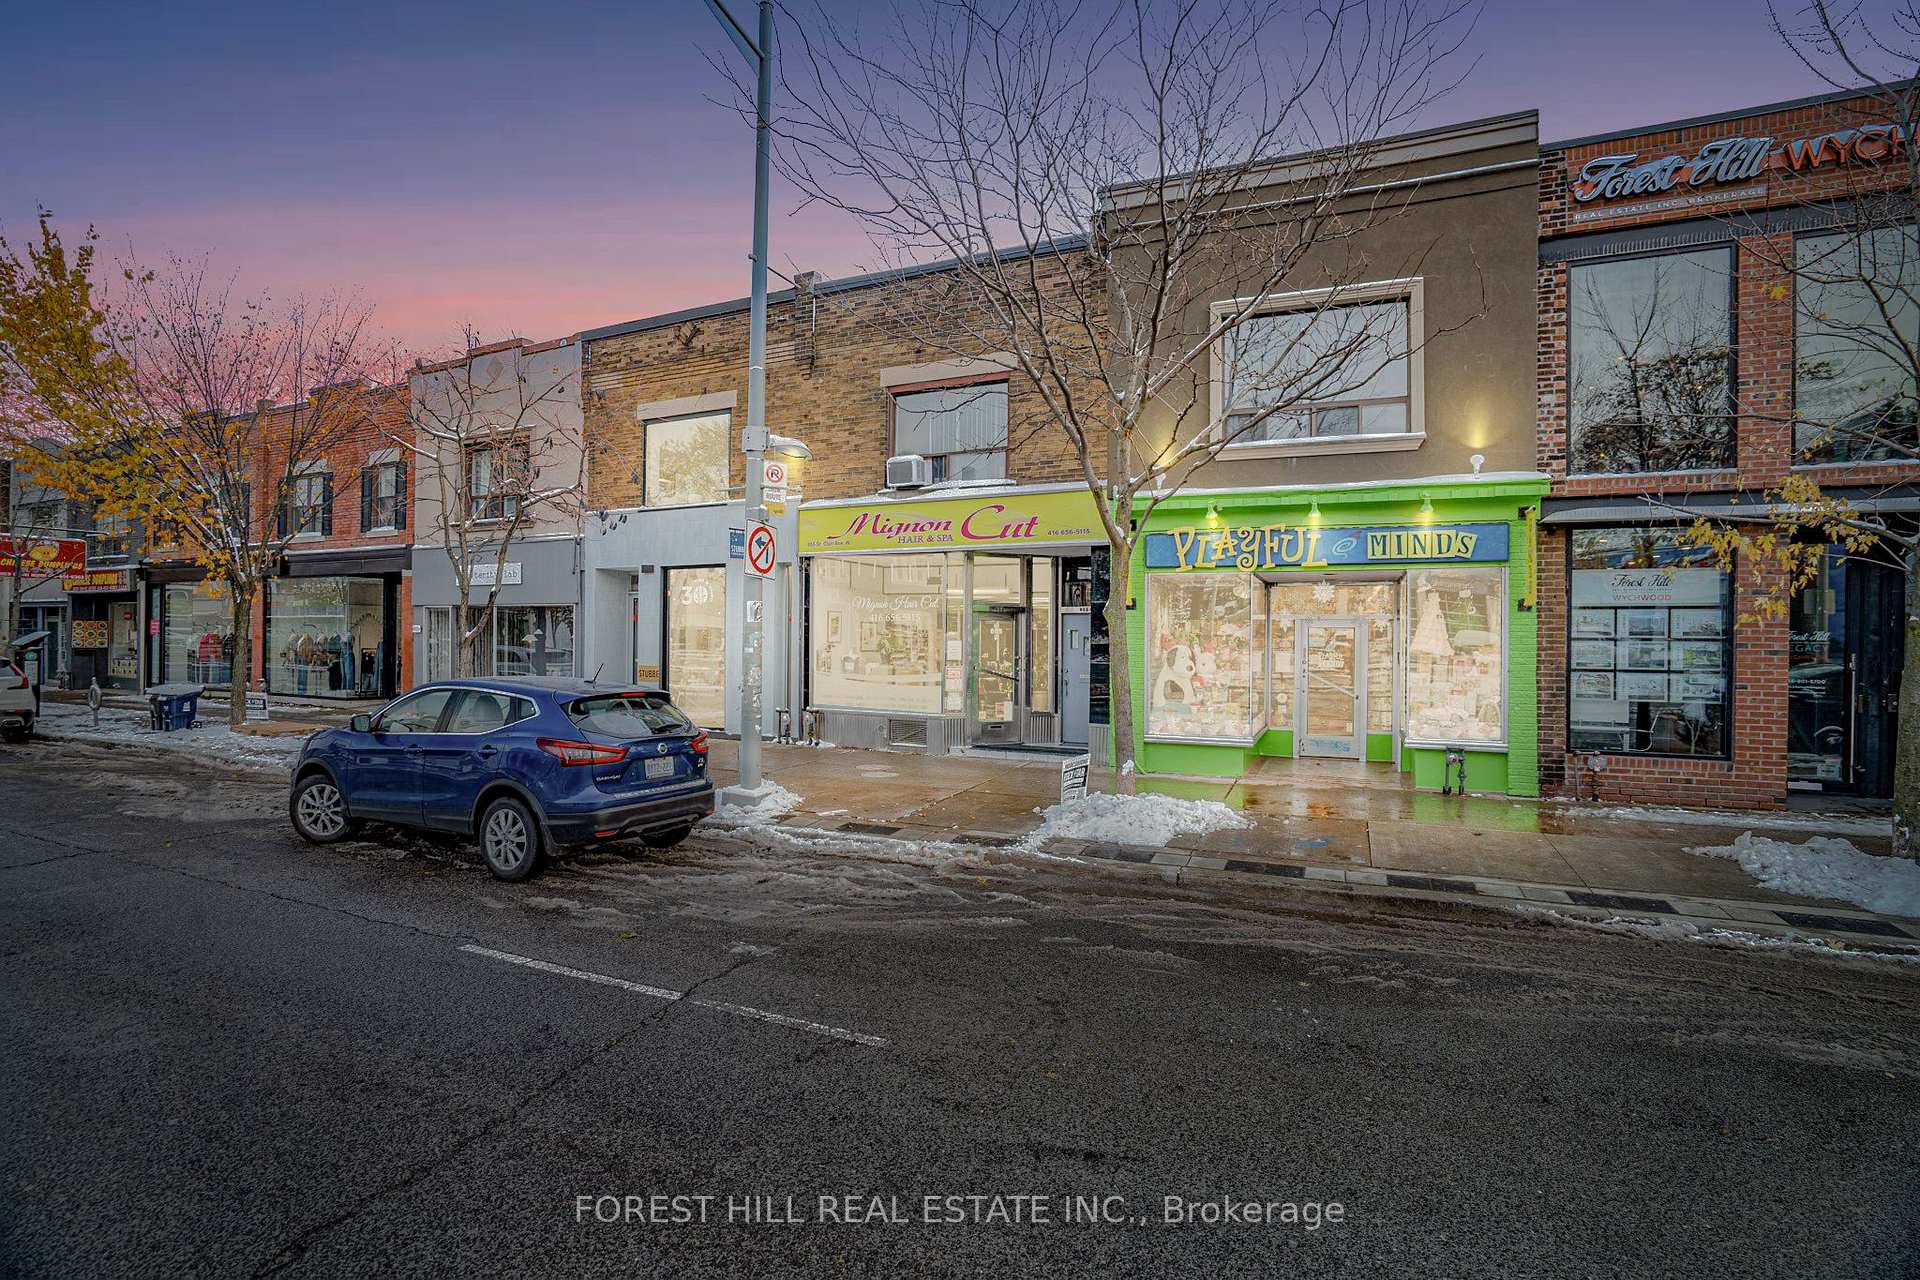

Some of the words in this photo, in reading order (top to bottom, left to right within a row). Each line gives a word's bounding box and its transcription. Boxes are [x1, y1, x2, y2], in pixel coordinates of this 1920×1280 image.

[1572, 153, 1687, 202] Forest
[1688, 136, 1776, 187] Hill
[1574, 211, 1602, 221] REAL
[1609, 204, 1650, 217] ESTATE
[827, 512, 953, 540] Mignon
[960, 503, 1039, 540] Cut
[897, 535, 925, 544] HAIR
[926, 534, 935, 543] &
[936, 534, 954, 543] SPA
[1168, 522, 1329, 573] PLAYFUL
[1370, 532, 1474, 558] MINDS
[0, 558, 36, 568] CHIESE
[1611, 573, 1646, 588] Forest
[1615, 593, 1672, 601] WYCHWOOD
